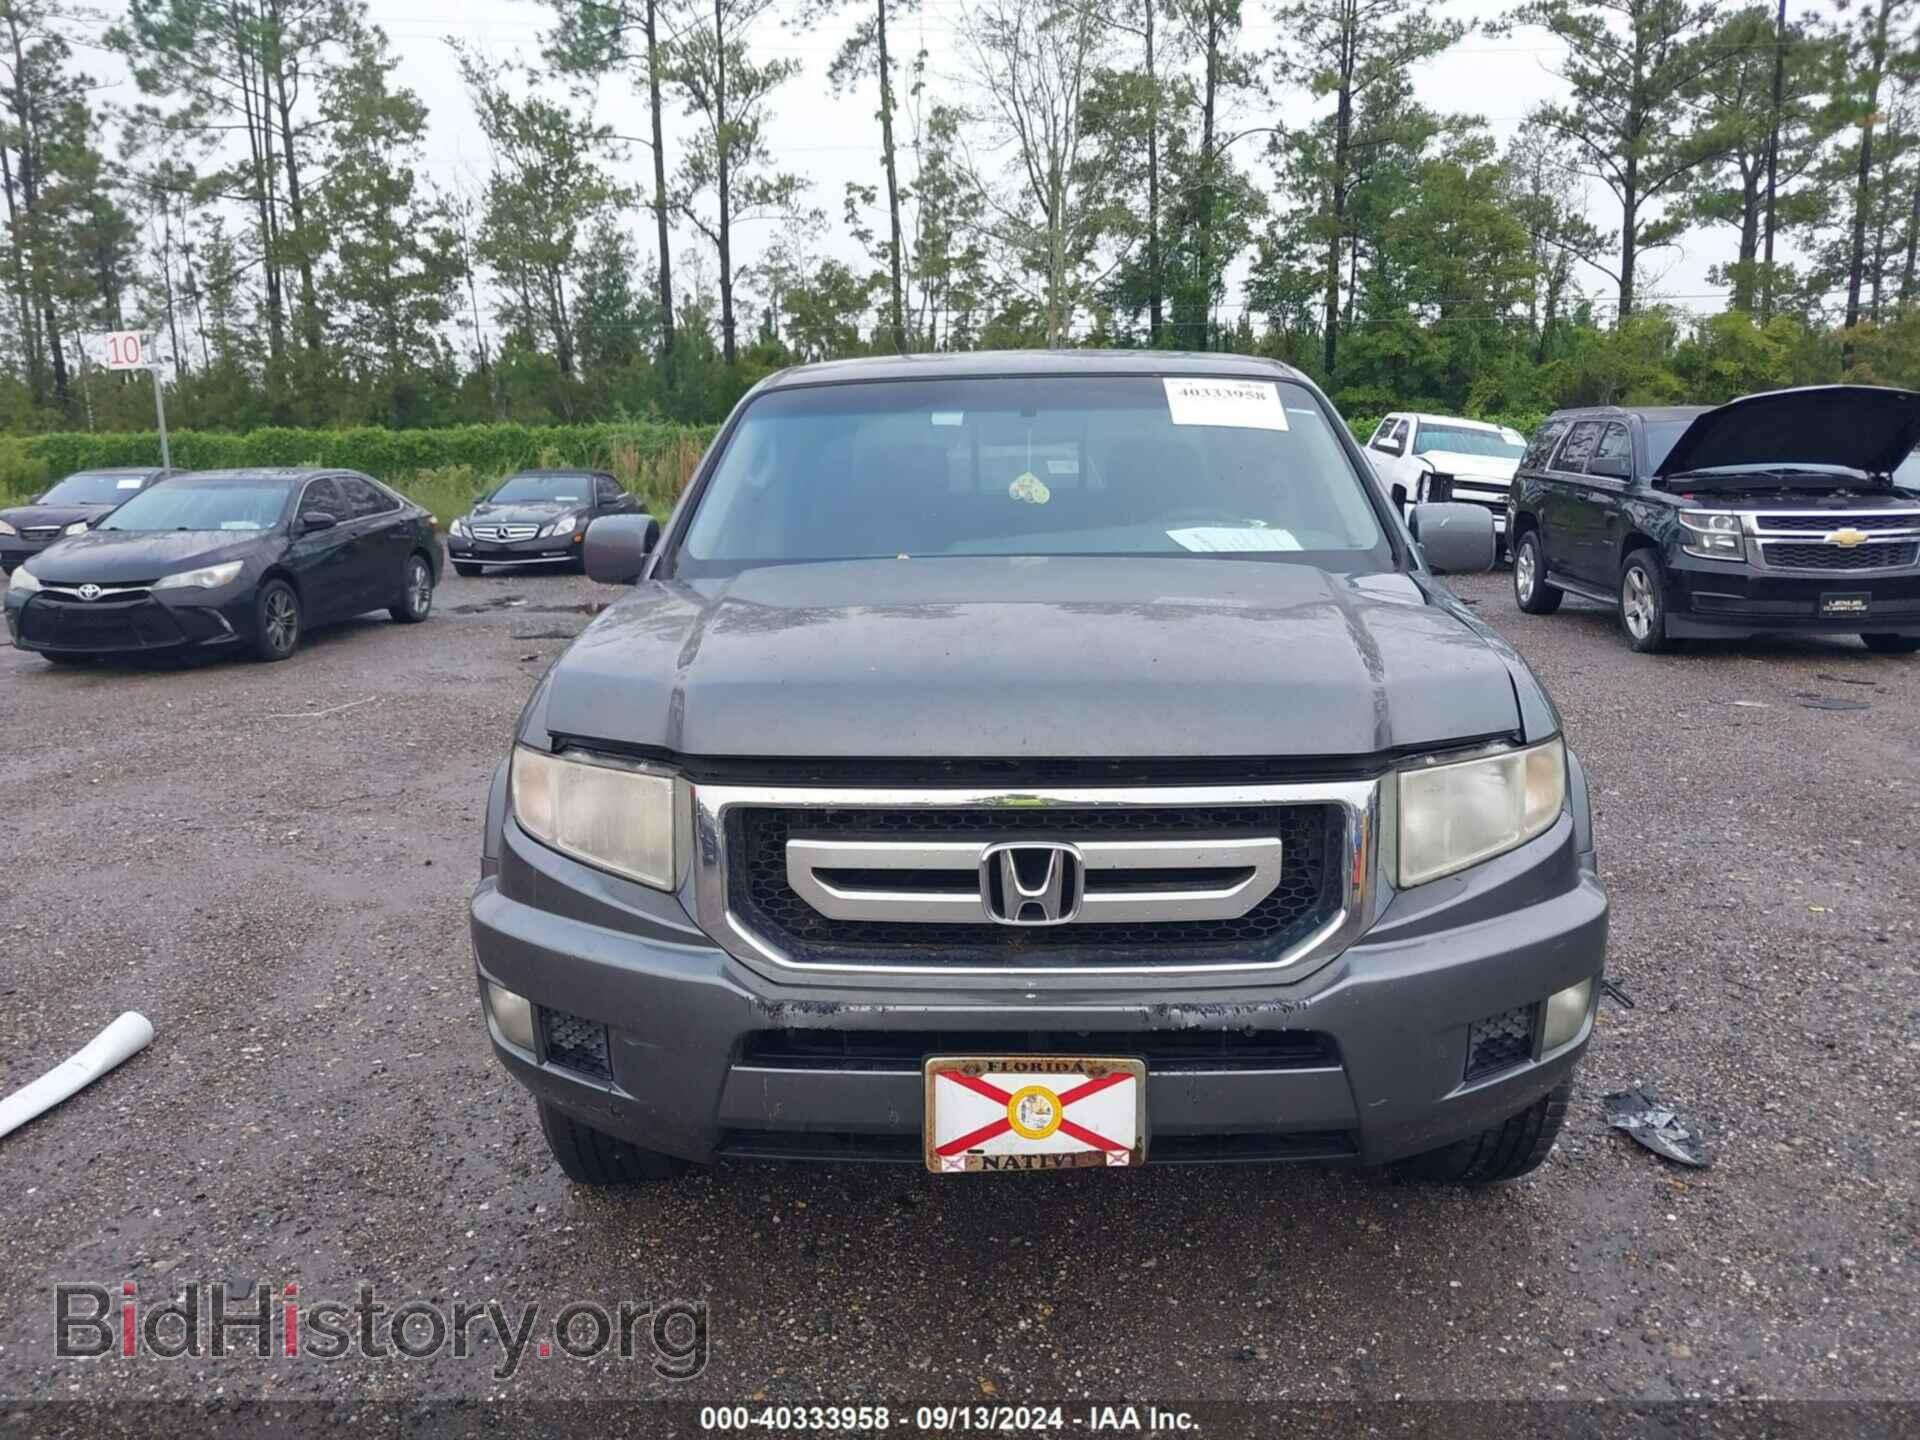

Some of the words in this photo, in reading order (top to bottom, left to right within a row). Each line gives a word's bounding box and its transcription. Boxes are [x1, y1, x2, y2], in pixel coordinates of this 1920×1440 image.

[109, 335, 139, 364] 10
[1178, 387, 1267, 401] 40333958
[987, 1061, 1085, 1073] FLORIDA
